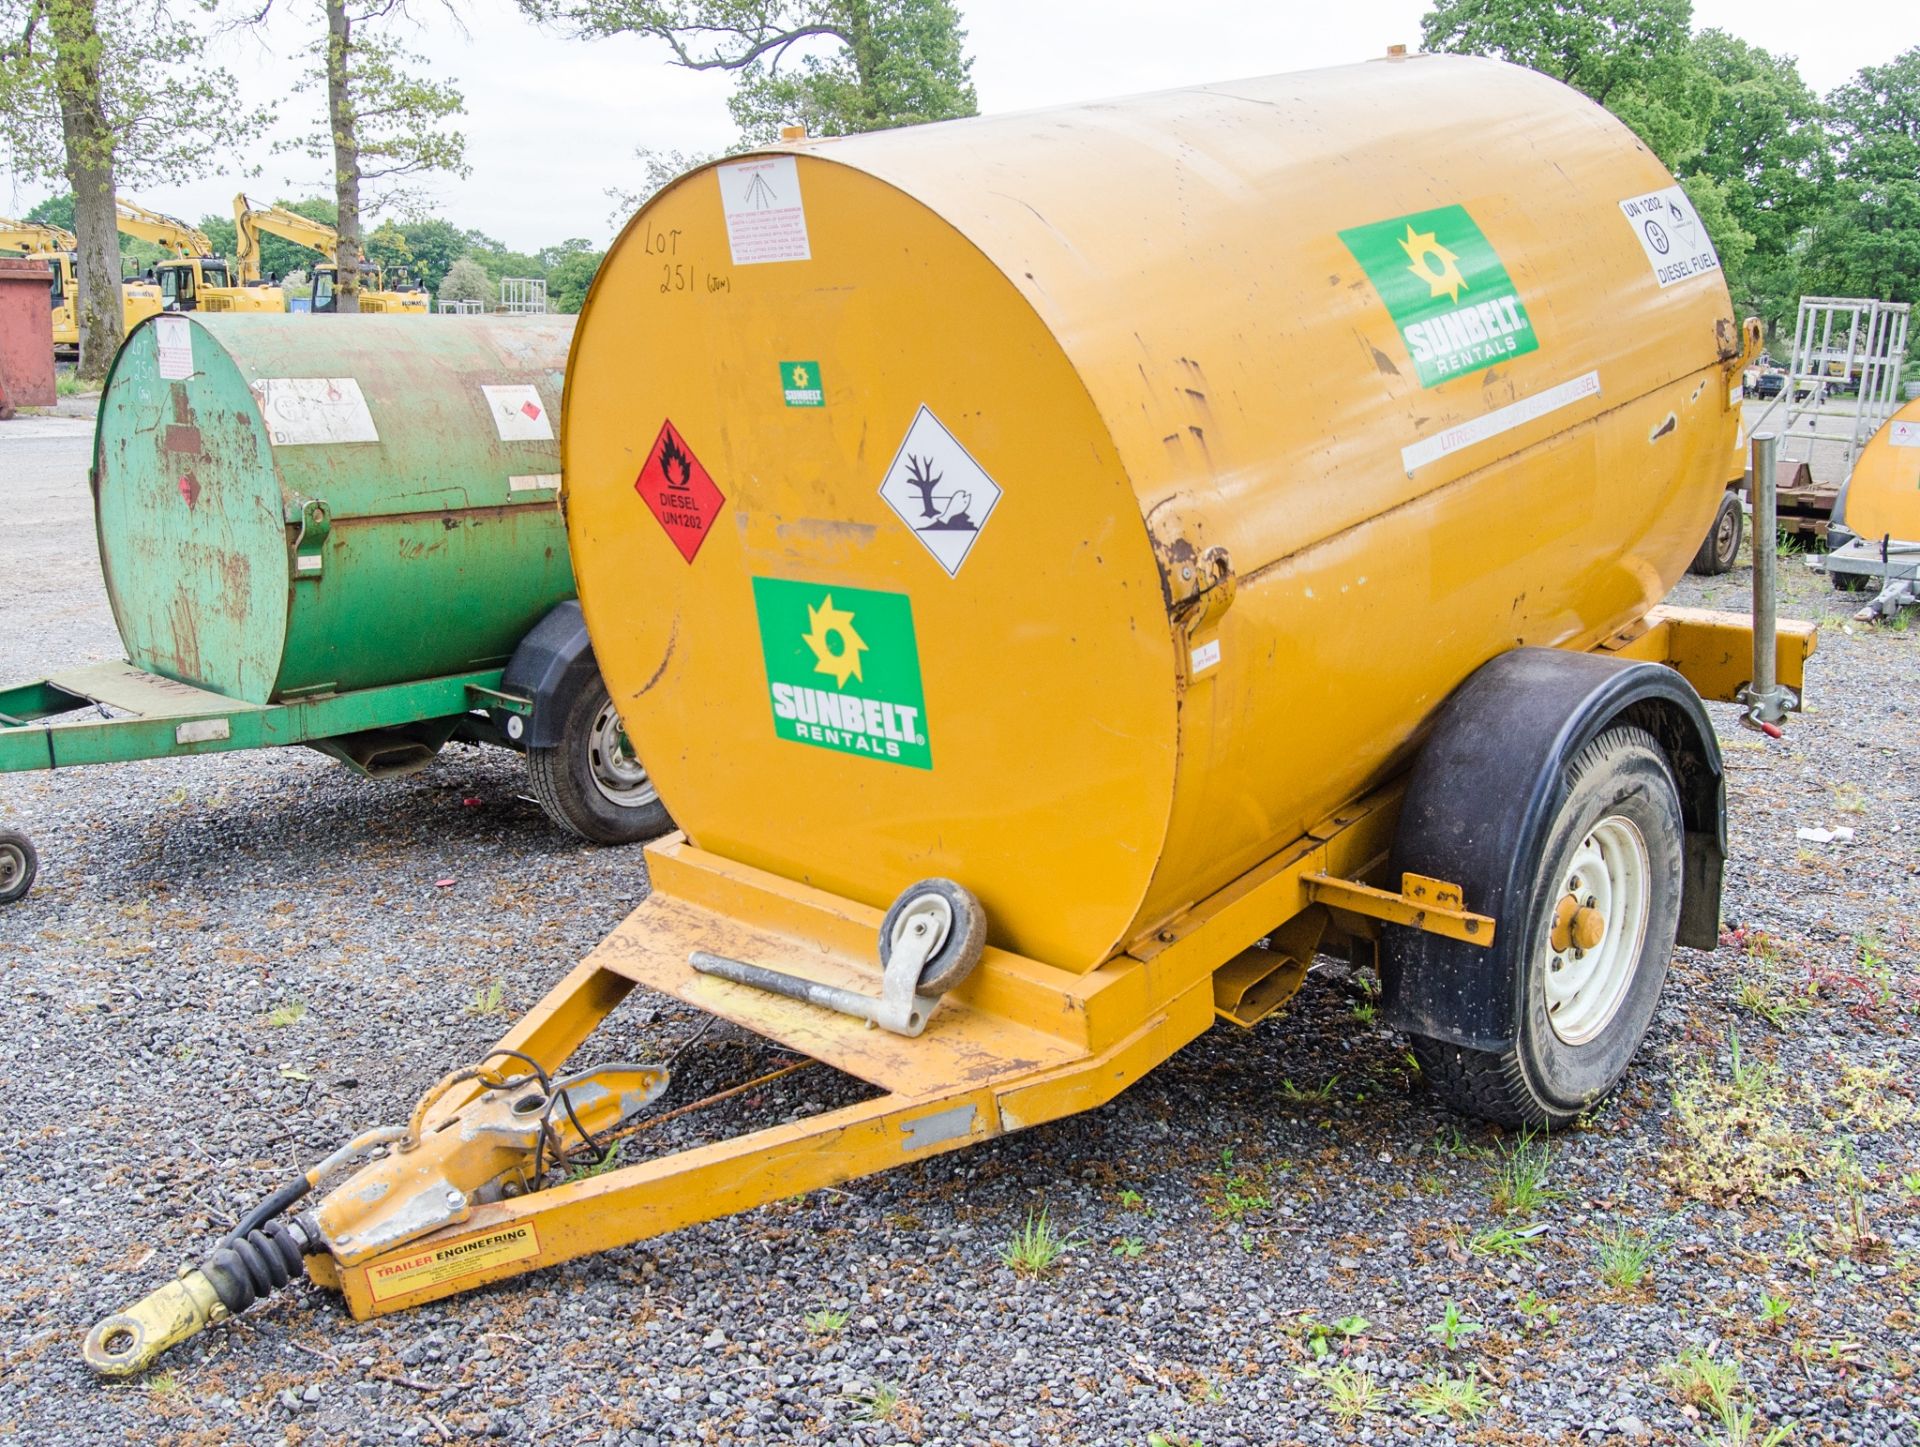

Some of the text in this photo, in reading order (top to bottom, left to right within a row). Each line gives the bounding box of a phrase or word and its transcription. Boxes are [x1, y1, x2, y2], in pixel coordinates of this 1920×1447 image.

[1623, 197, 1663, 217] UN 1202
[645, 221, 682, 256] LOT
[660, 264, 694, 294] 251
[1657, 252, 1716, 284] DIESEL FUEL
[1436, 336, 1516, 375] RENTALS
[659, 492, 699, 511] DIESEL
[662, 511, 702, 529] UN1202
[796, 723, 900, 757] RENTALS
[376, 1256, 433, 1278] TRAILER
